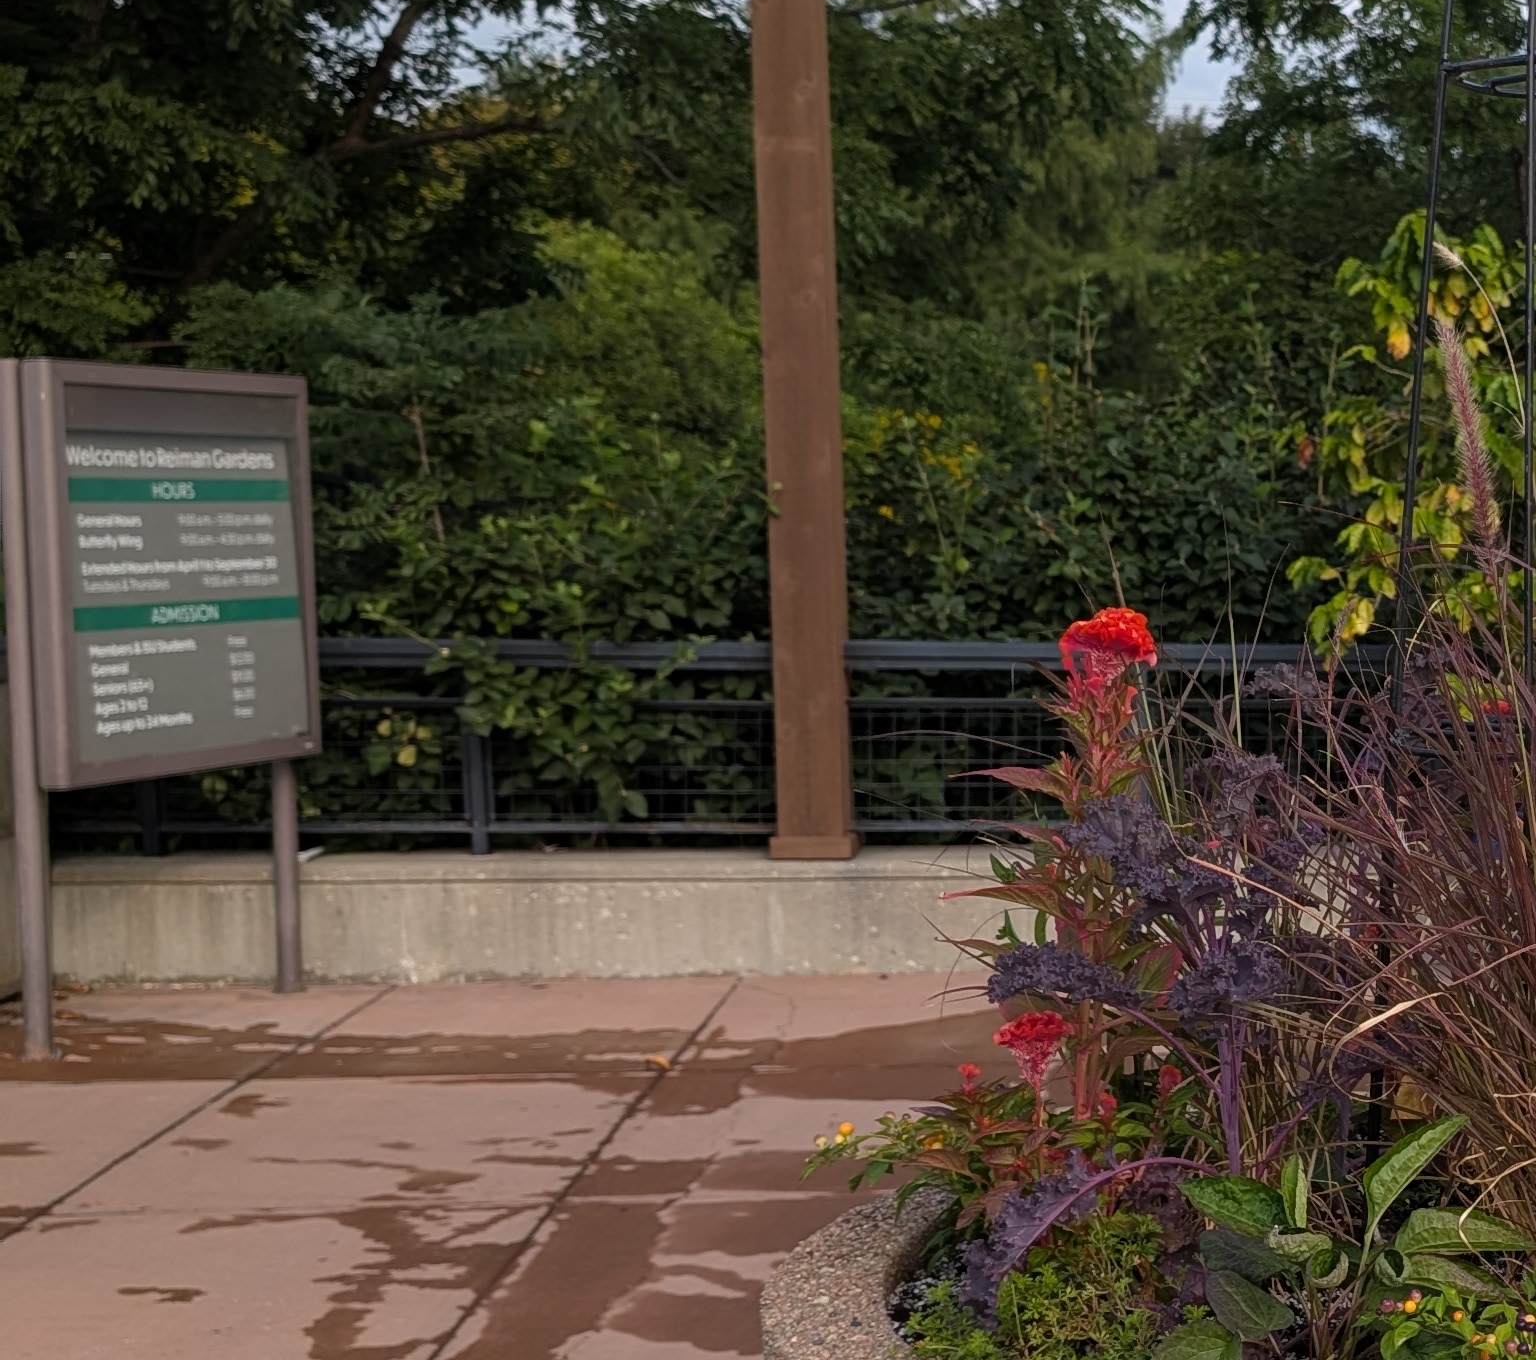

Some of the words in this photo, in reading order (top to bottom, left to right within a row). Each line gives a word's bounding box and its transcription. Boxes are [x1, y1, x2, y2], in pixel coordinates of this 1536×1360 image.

[65, 444, 138, 468] Welcome
[140, 448, 156, 468] to
[157, 447, 211, 469] Reiman
[212, 448, 275, 470] Gardens
[151, 481, 196, 500] HOURS
[151, 603, 220, 624] ADMISSION
